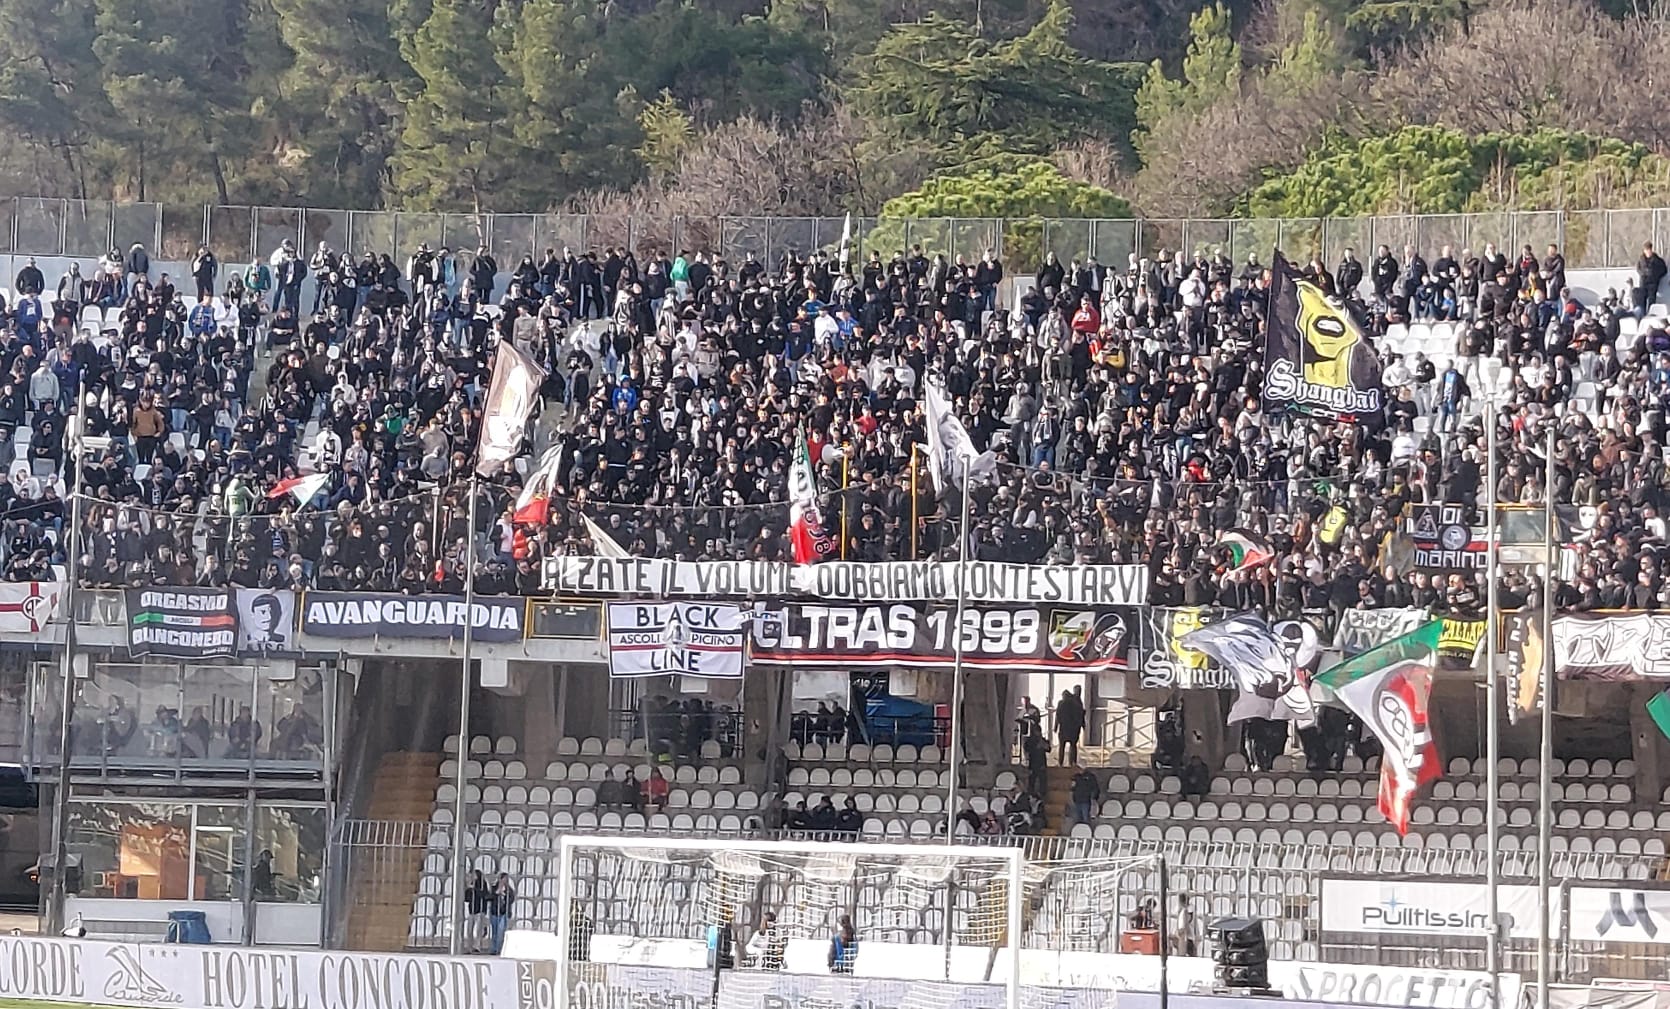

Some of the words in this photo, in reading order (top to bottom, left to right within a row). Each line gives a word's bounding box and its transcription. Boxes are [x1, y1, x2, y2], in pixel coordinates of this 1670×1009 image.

[1264, 358, 1379, 411] Shanghai
[544, 558, 652, 591] ALZATE
[661, 562, 685, 593] IL
[695, 562, 802, 594] VOLUME
[953, 562, 1148, 605] CONTESTARVI
[140, 591, 229, 611] ORGASMO
[307, 600, 520, 630] AVANGUARDIA
[636, 605, 721, 628] BLACK
[752, 602, 917, 650] ULTRAS
[926, 609, 1041, 655] 1898
[619, 634, 661, 645] ASCOLI
[649, 650, 702, 672] LINE
[201, 951, 309, 1009] HOTEL
[318, 955, 495, 1009] CONCORDE
